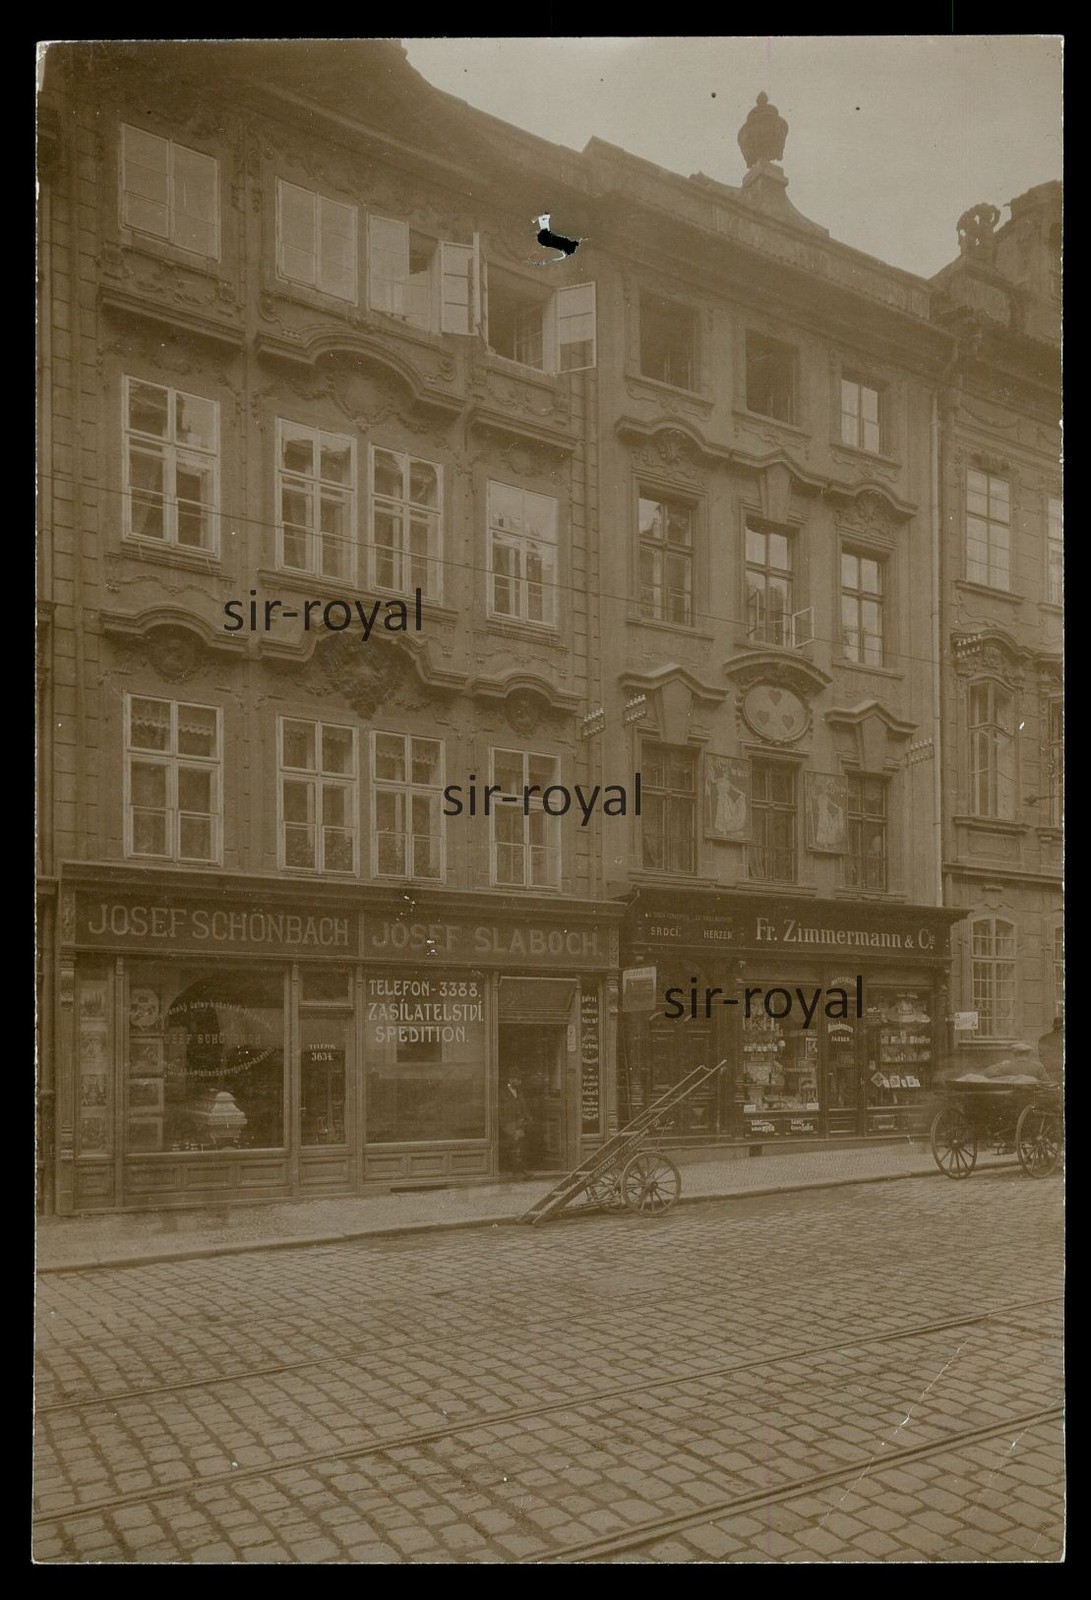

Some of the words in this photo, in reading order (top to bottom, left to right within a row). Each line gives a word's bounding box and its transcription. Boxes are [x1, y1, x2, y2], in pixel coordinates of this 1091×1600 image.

[88, 903, 187, 938] JOSEF
[192, 908, 350, 946] SCHÖNBACH
[372, 922, 459, 949] JOSEF
[756, 917, 777, 942] Fr.
[783, 919, 902, 949] Zimmermann
[904, 934, 915, 949] &
